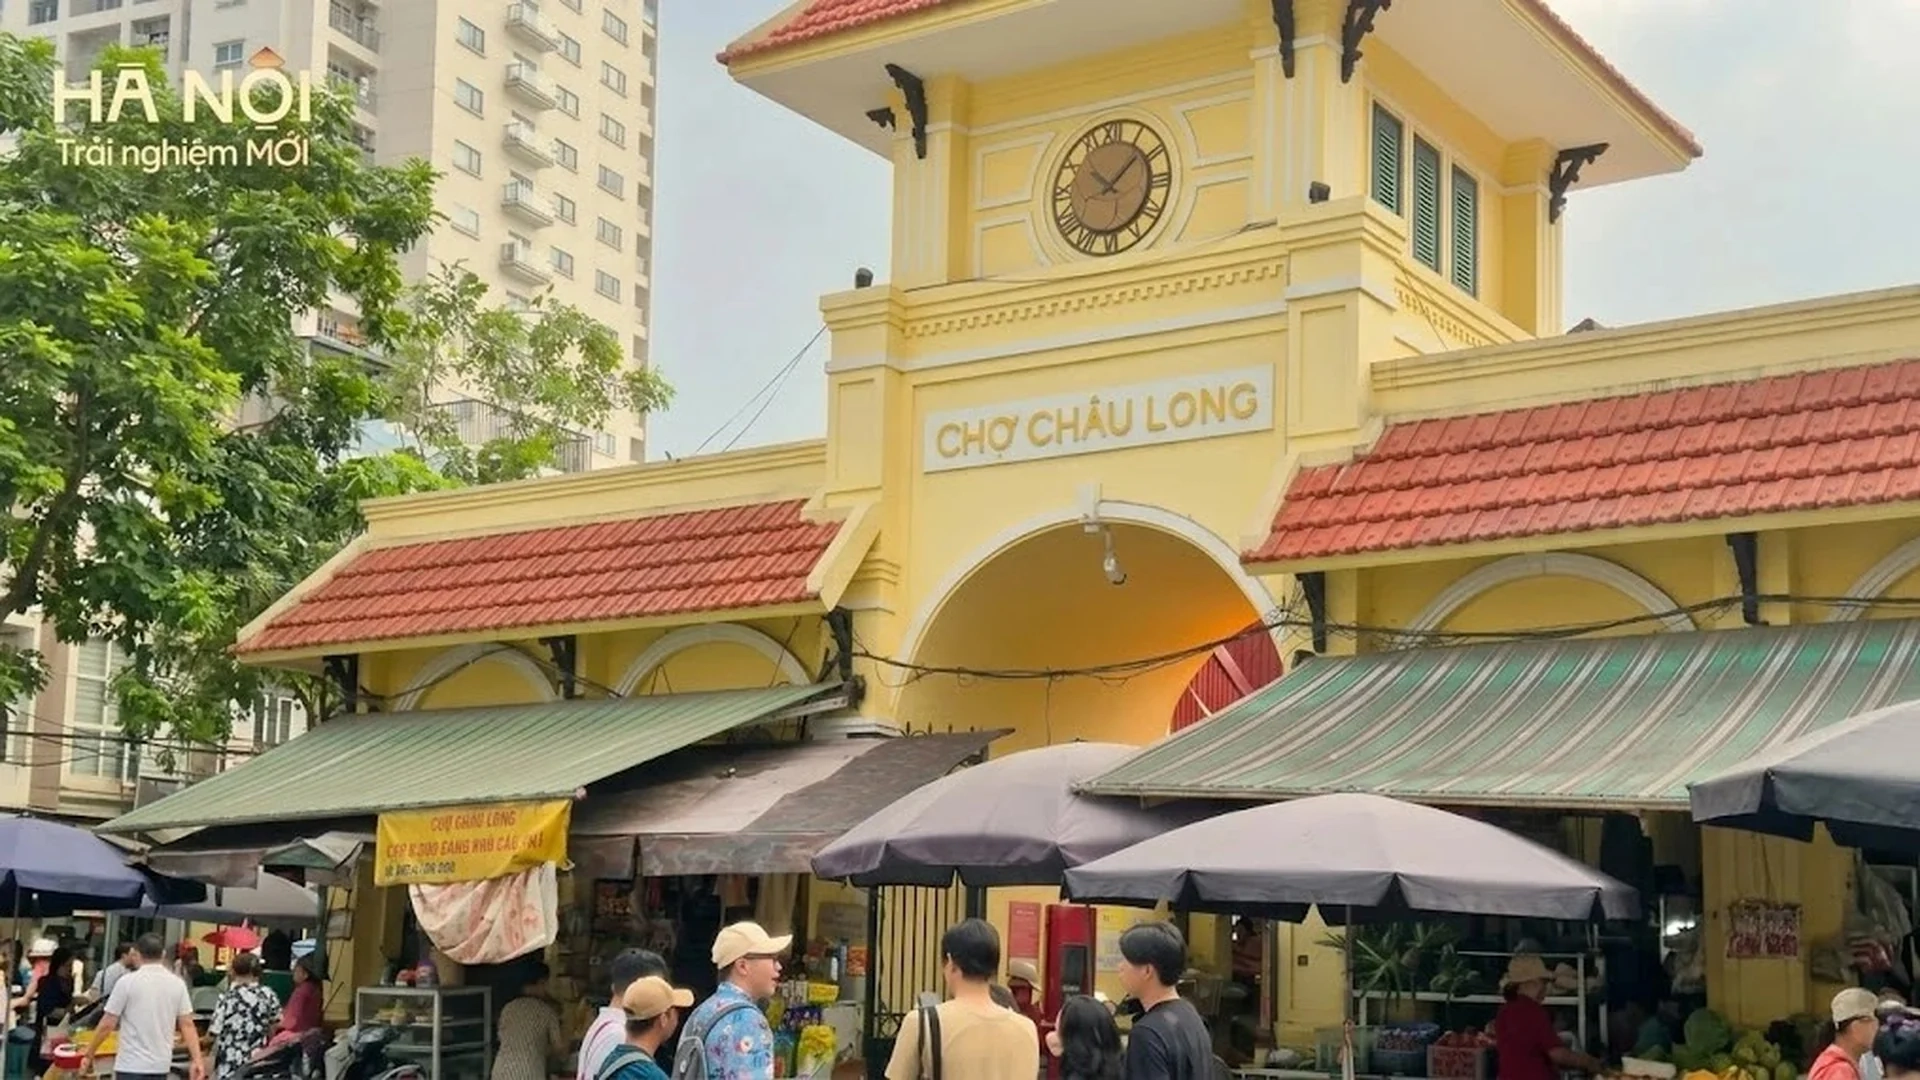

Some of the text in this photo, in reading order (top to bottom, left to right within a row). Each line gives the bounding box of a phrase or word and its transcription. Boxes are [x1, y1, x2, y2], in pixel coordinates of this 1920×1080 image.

[937, 382, 1258, 458] CHỢ CHÂU LONG
